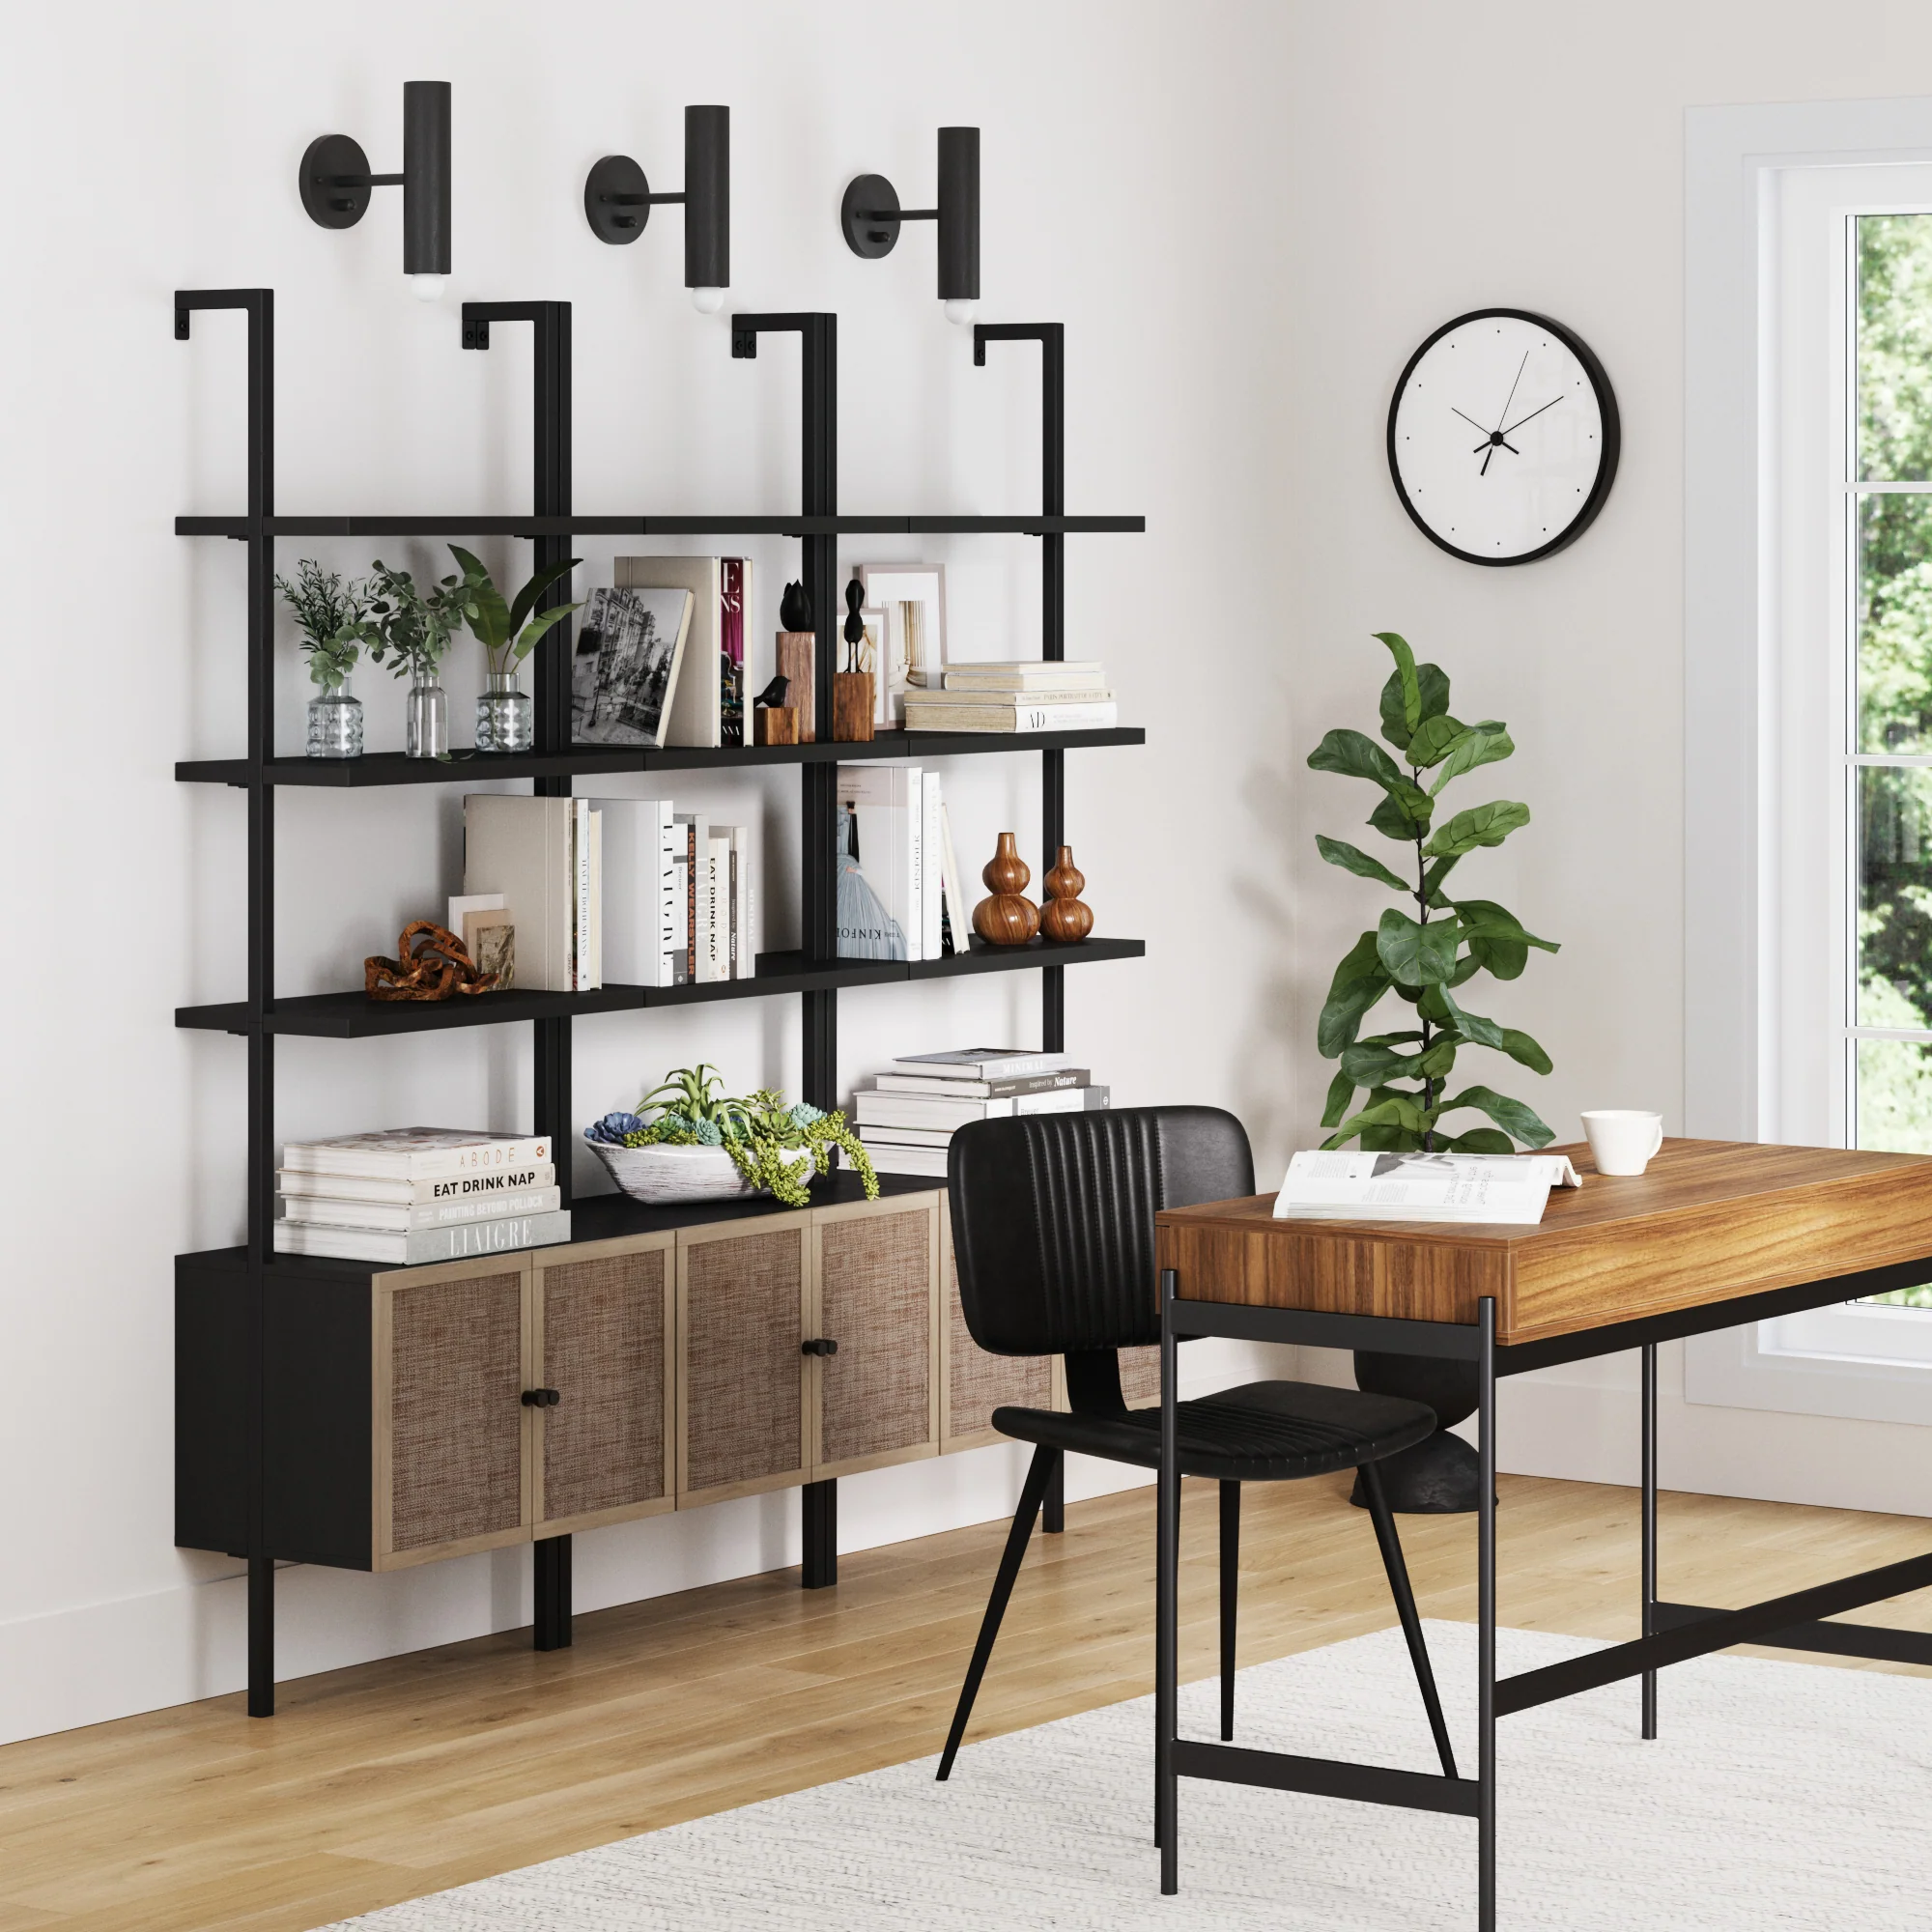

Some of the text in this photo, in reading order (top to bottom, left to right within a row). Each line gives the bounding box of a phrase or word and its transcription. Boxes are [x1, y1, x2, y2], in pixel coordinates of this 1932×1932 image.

[1029, 1079, 1046, 1089] Inspired
[1054, 1075, 1077, 1088] Nature
[460, 1148, 515, 1168] ABODE
[434, 1181, 460, 1197] EAT
[463, 1176, 504, 1193] DRINK
[507, 1172, 535, 1187] NAP
[439, 1205, 475, 1221] PAINTING
[476, 1200, 507, 1216] BEYOND
[509, 1194, 544, 1211] POLLOCK
[450, 1219, 532, 1256] LIAIGRE
